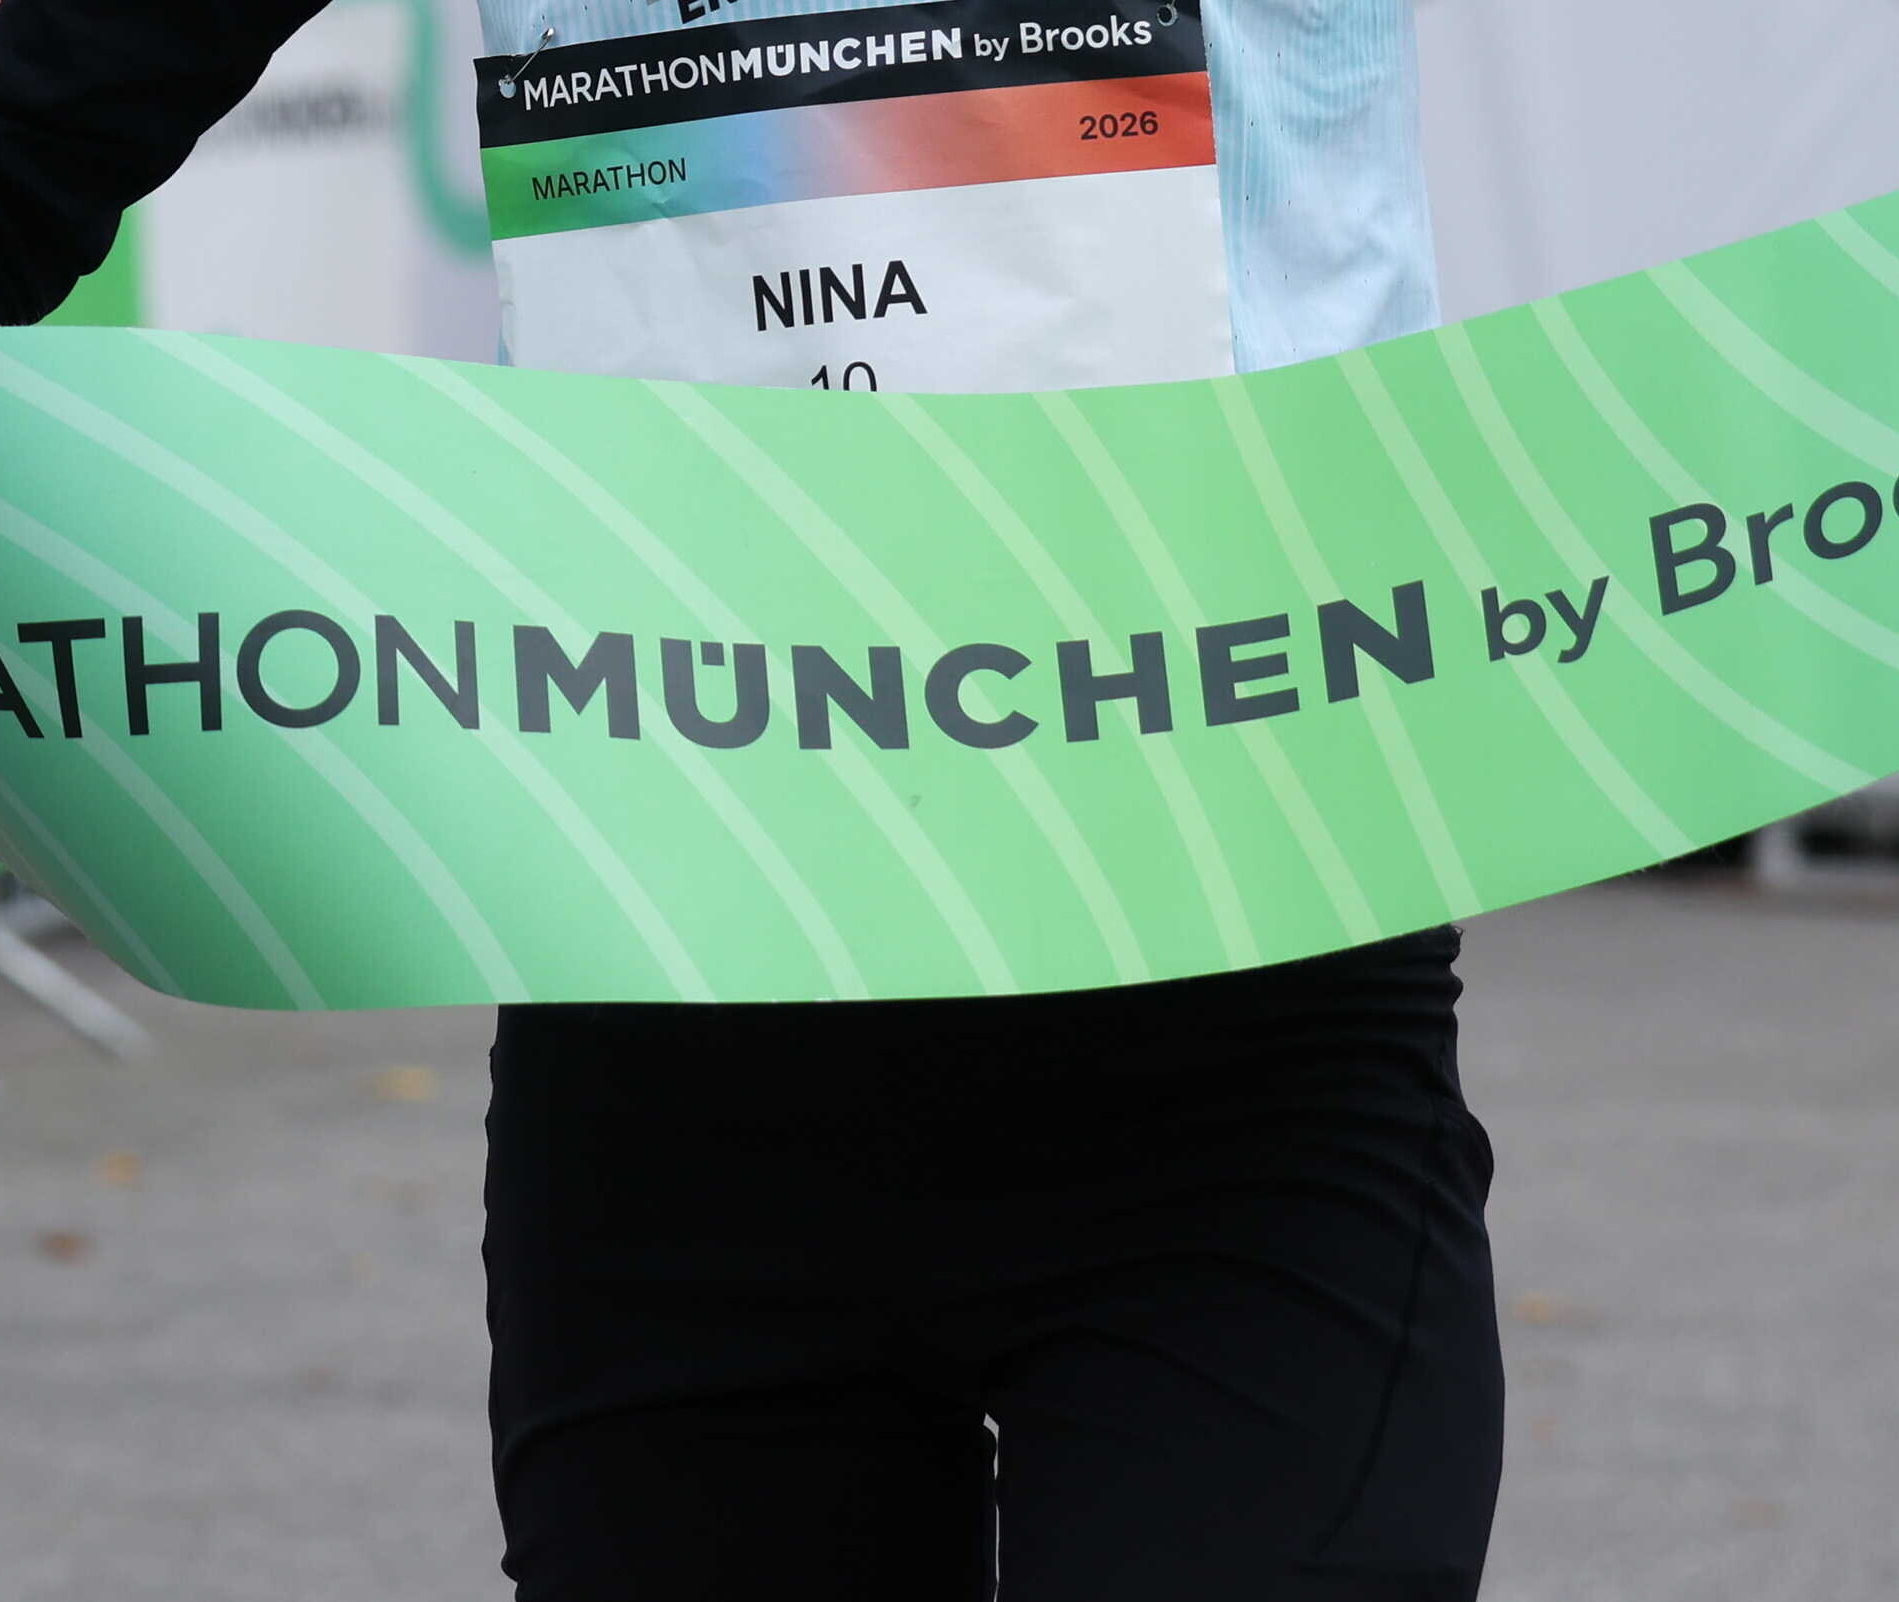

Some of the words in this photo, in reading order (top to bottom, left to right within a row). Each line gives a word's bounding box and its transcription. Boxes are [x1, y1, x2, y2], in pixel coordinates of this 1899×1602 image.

[974, 30, 1010, 62] by
[1019, 14, 1153, 56] Brooks
[532, 157, 688, 201] MARATHON
[1079, 110, 1160, 141] 2026
[752, 259, 928, 332] NINA
[1481, 575, 1610, 664] by
